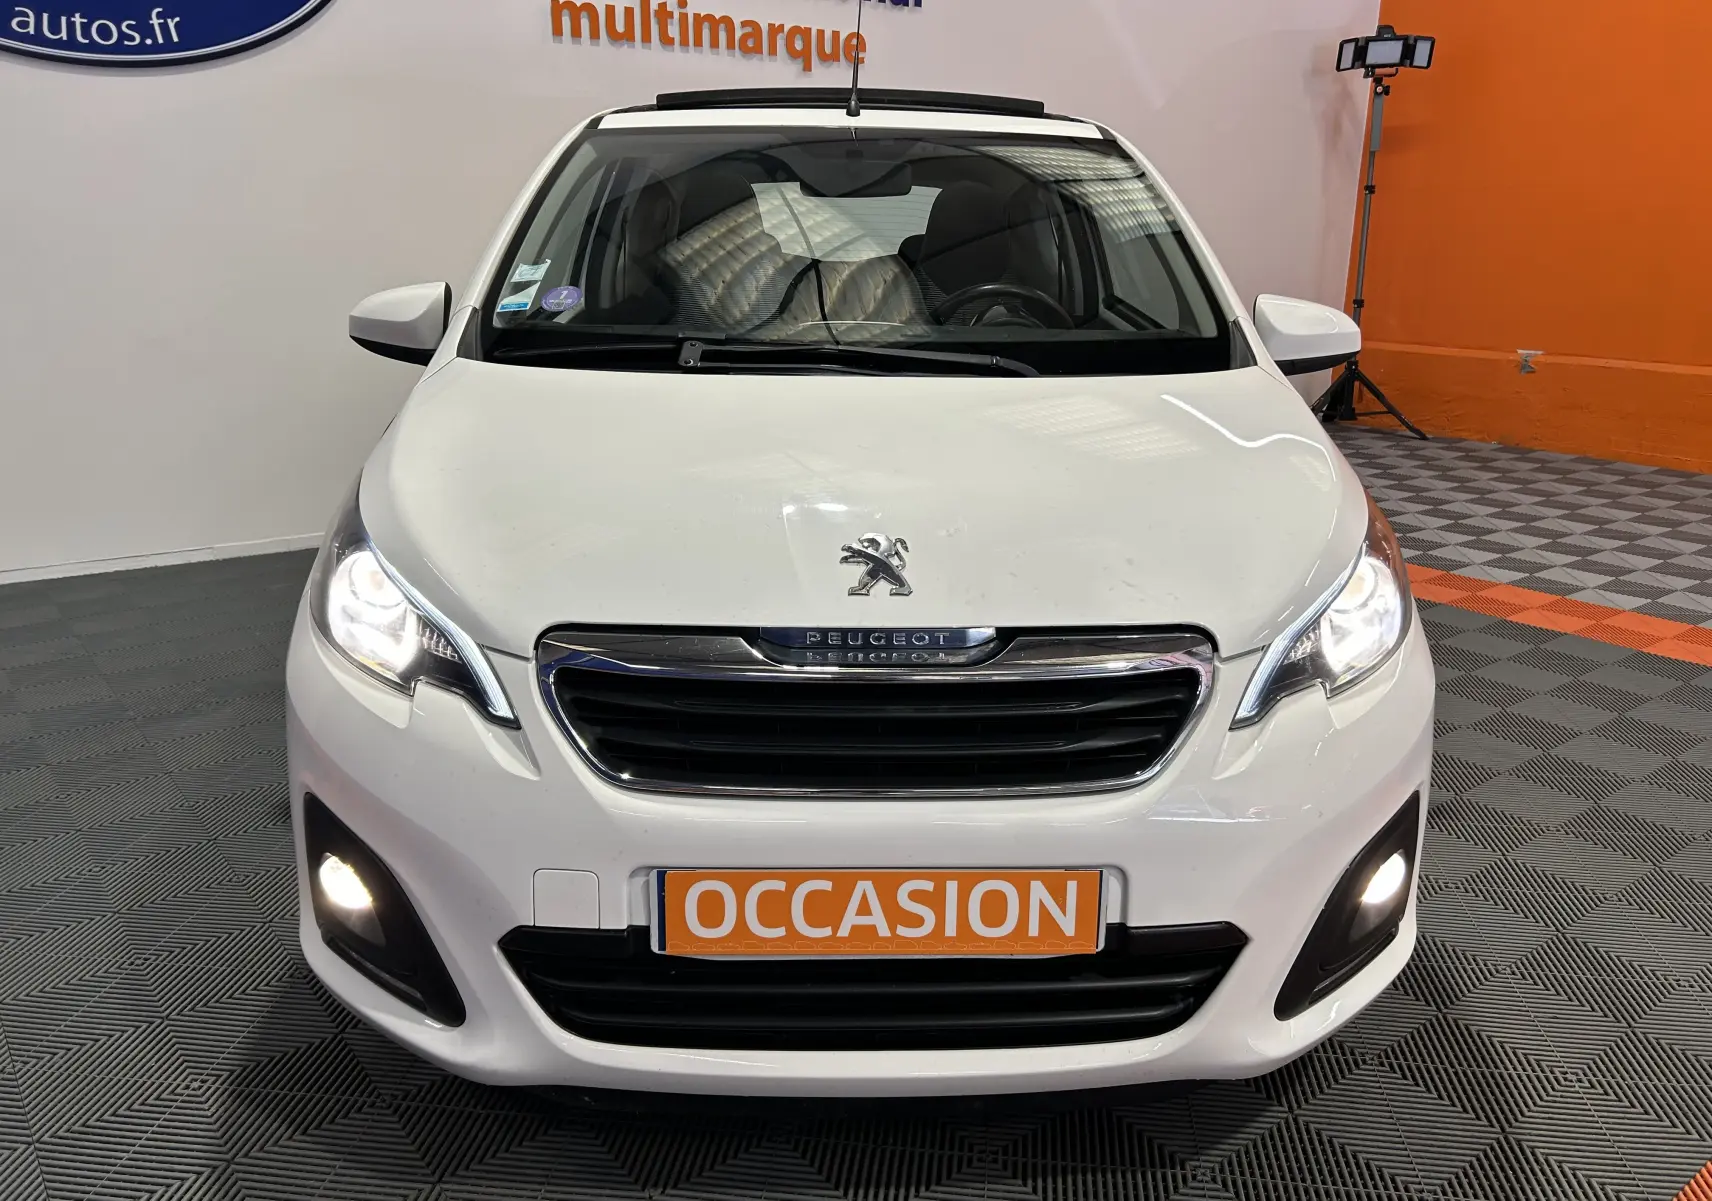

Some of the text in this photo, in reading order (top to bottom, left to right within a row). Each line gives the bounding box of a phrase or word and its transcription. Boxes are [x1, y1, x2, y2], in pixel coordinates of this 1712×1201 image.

[10, 6, 181, 46] autos.fr
[550, 0, 867, 72] multimarque
[806, 631, 950, 645] PEUGEOT
[684, 879, 1078, 938] OCCASION
